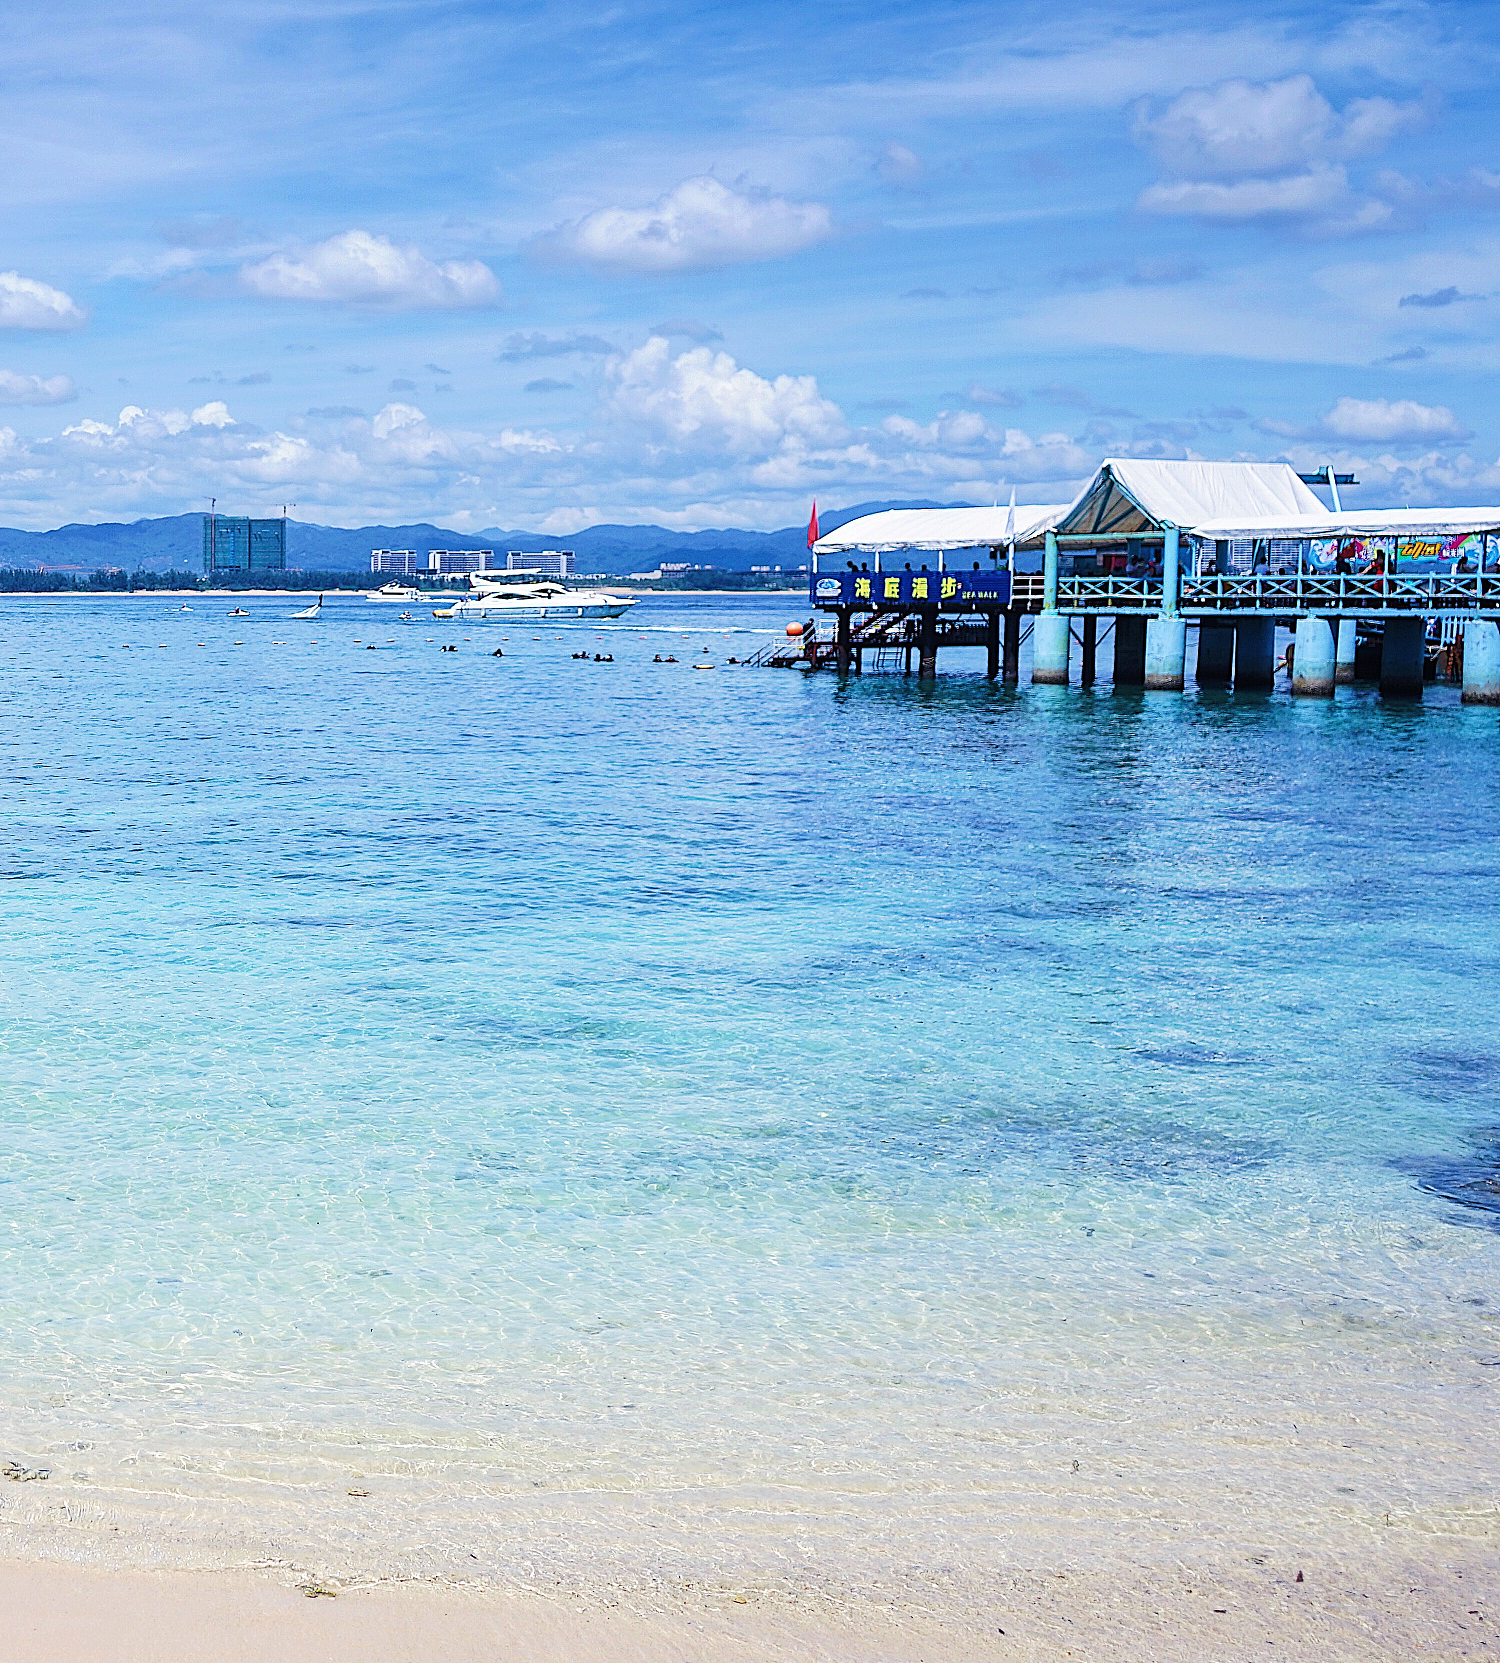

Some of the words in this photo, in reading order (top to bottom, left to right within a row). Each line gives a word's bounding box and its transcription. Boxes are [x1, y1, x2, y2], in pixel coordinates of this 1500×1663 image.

[855, 577, 956, 599] 海底漫步
[962, 591, 976, 599] SEA
